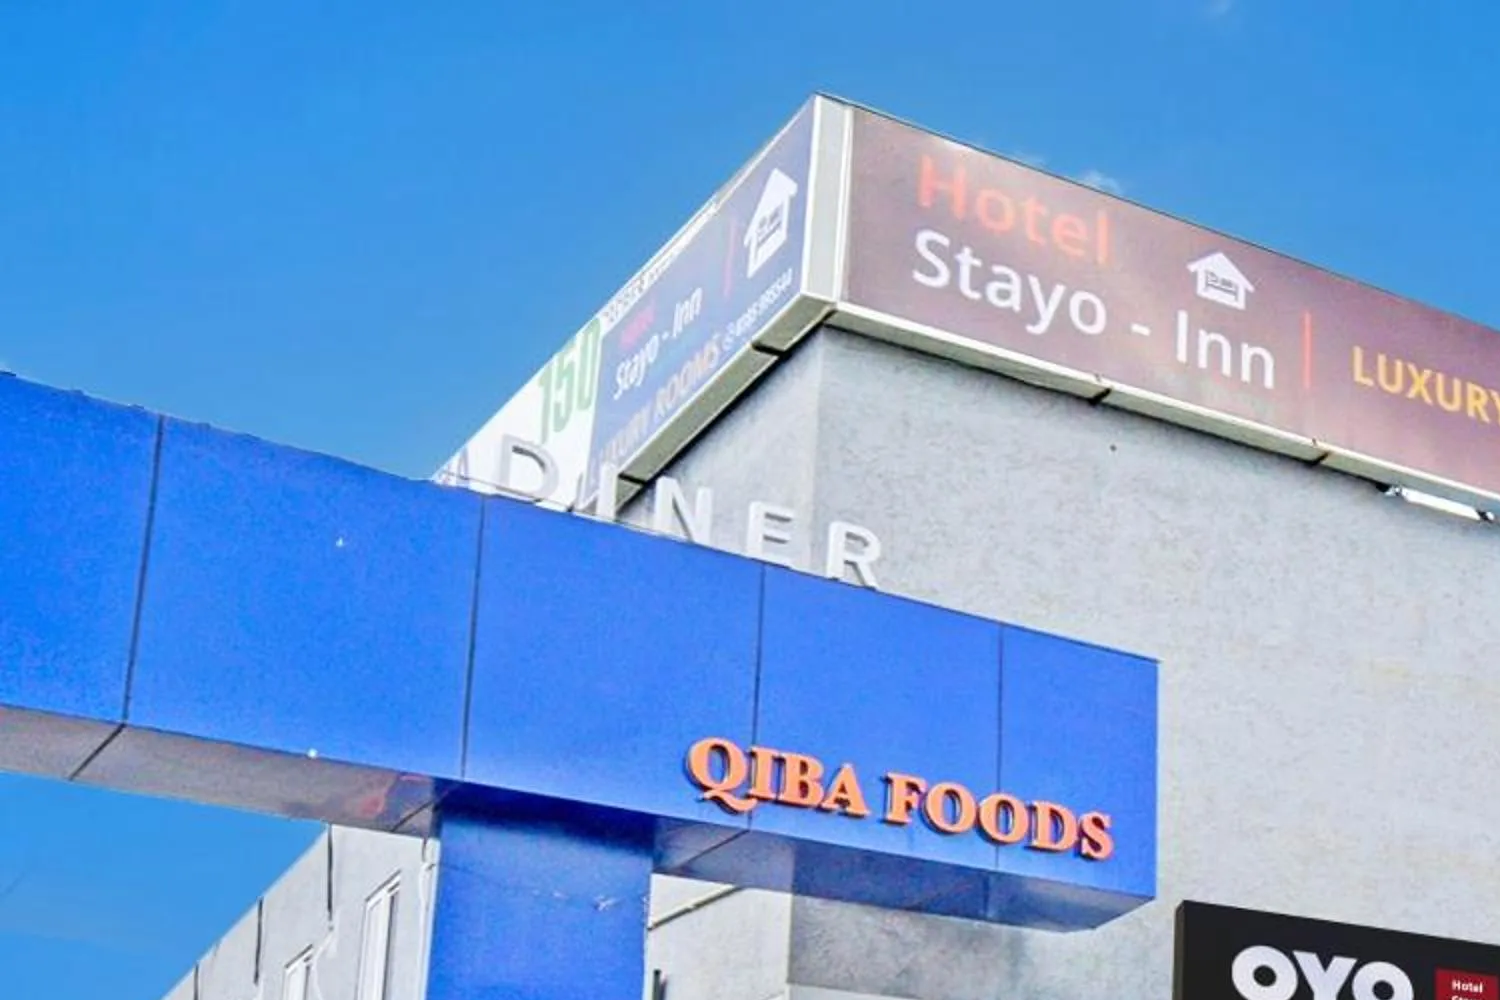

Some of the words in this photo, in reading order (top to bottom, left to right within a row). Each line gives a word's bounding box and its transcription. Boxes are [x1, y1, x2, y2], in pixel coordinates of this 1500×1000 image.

[917, 154, 1111, 265] Hotel
[911, 229, 1108, 336] Stayo
[1174, 309, 1276, 390] Inn
[686, 736, 870, 813] QIBA
[882, 770, 1115, 860] FOODS
[1451, 979, 1483, 994] Hotel
